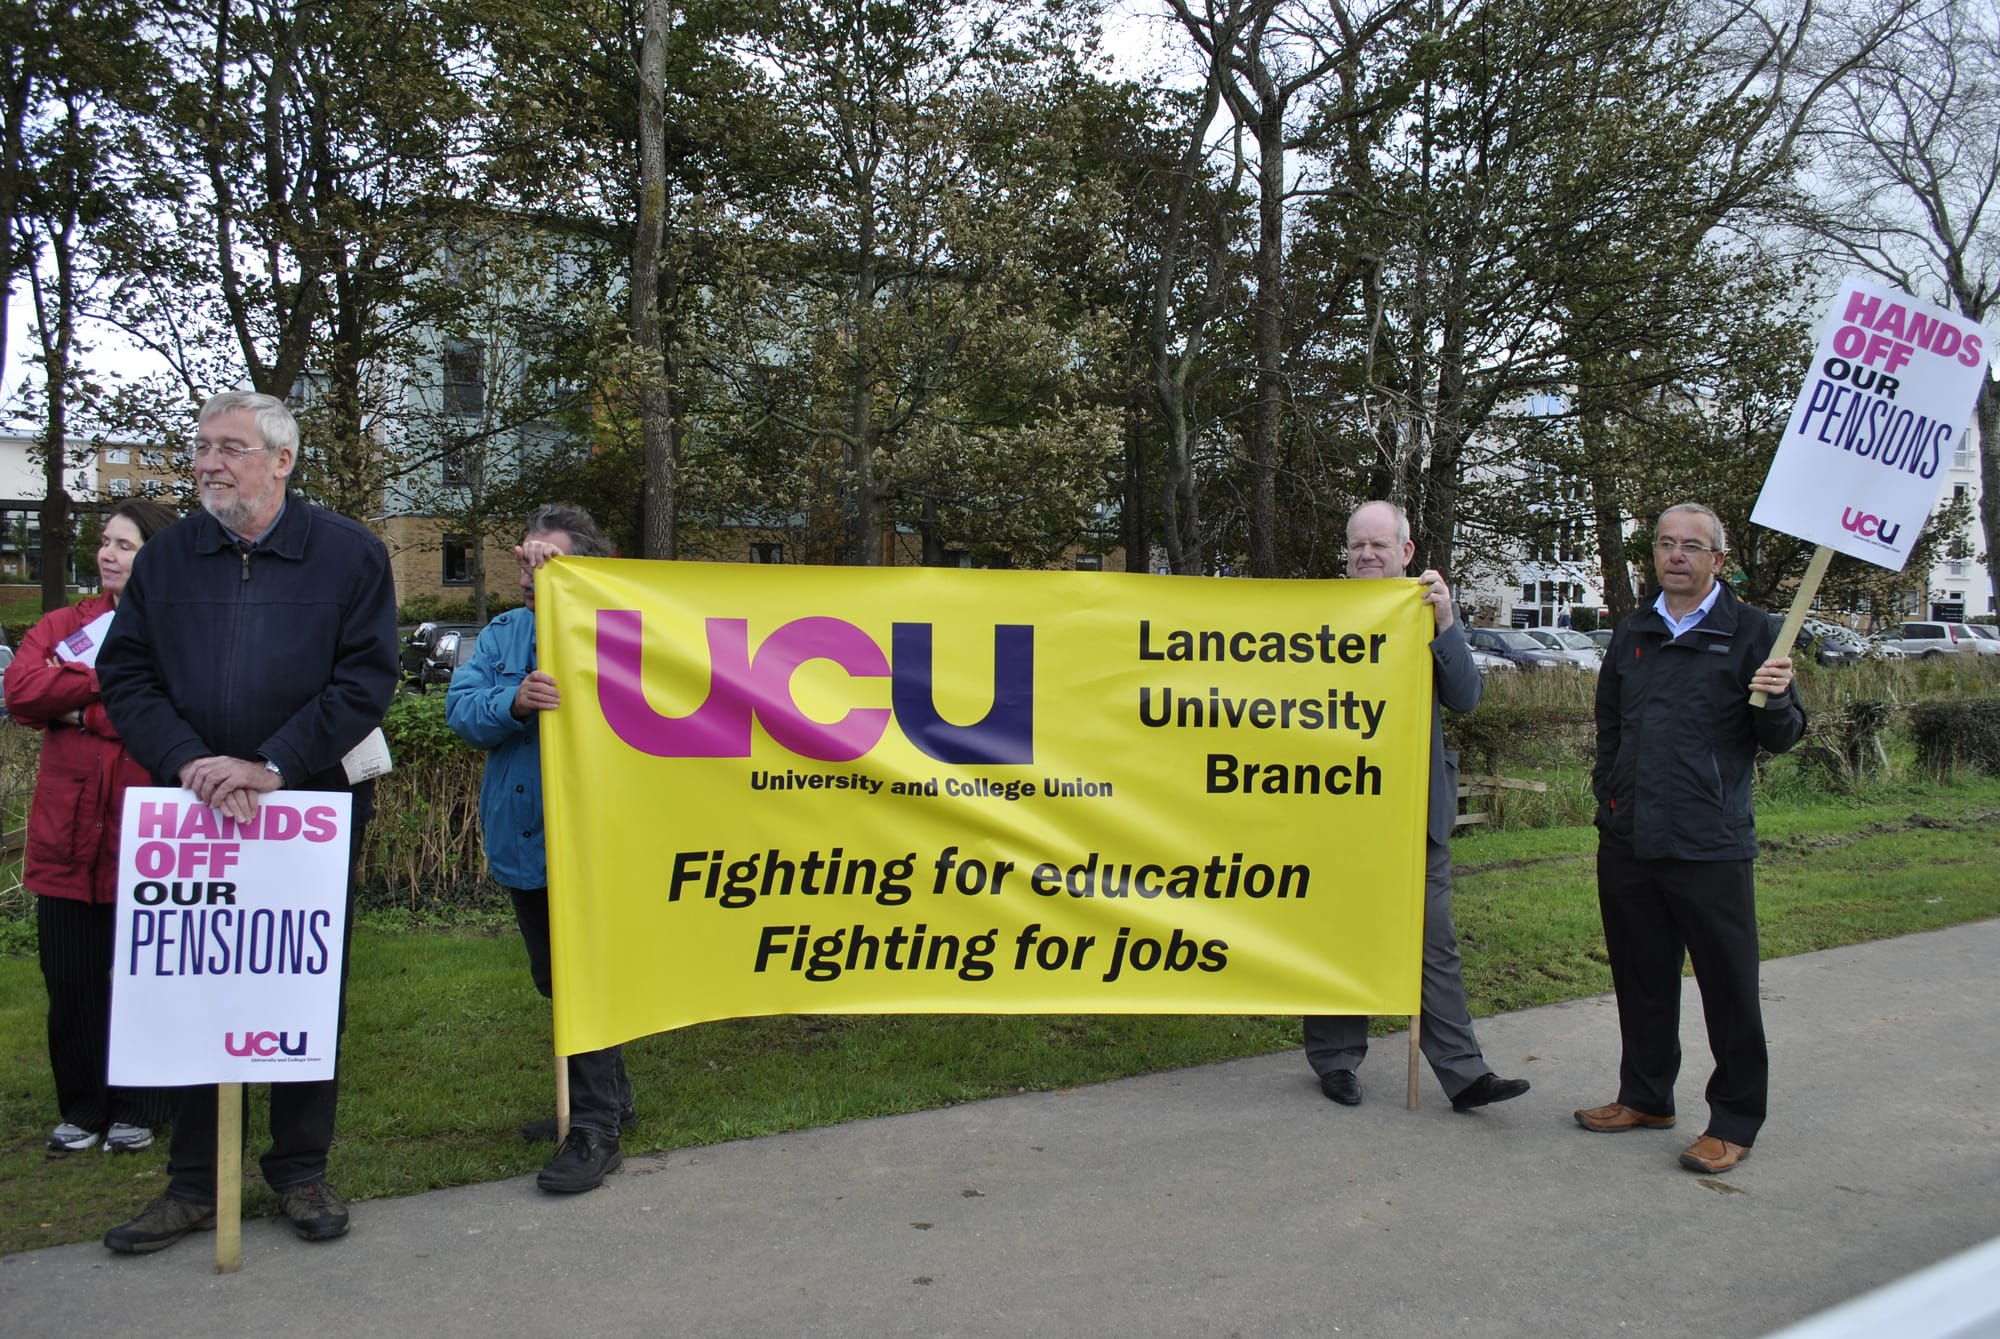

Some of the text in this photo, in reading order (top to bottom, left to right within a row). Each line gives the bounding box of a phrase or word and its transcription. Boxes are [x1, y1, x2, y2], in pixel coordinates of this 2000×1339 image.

[1832, 325, 1915, 374] OFF
[1842, 291, 1983, 368] HANDS
[1822, 357, 1900, 400] OUR
[1798, 379, 1953, 479] PENSIONS
[1138, 620, 1387, 665] Lancaster
[1138, 687, 1387, 740] University
[750, 770, 1114, 801] University and College Union
[1206, 754, 1382, 796] Branch
[138, 802, 338, 843] HANDS
[135, 841, 241, 879] OFF
[668, 846, 1312, 909] Fighting for education
[133, 881, 237, 906] OUR
[130, 909, 331, 976] PENSIONS
[753, 923, 1230, 983] Fighting for jobs
